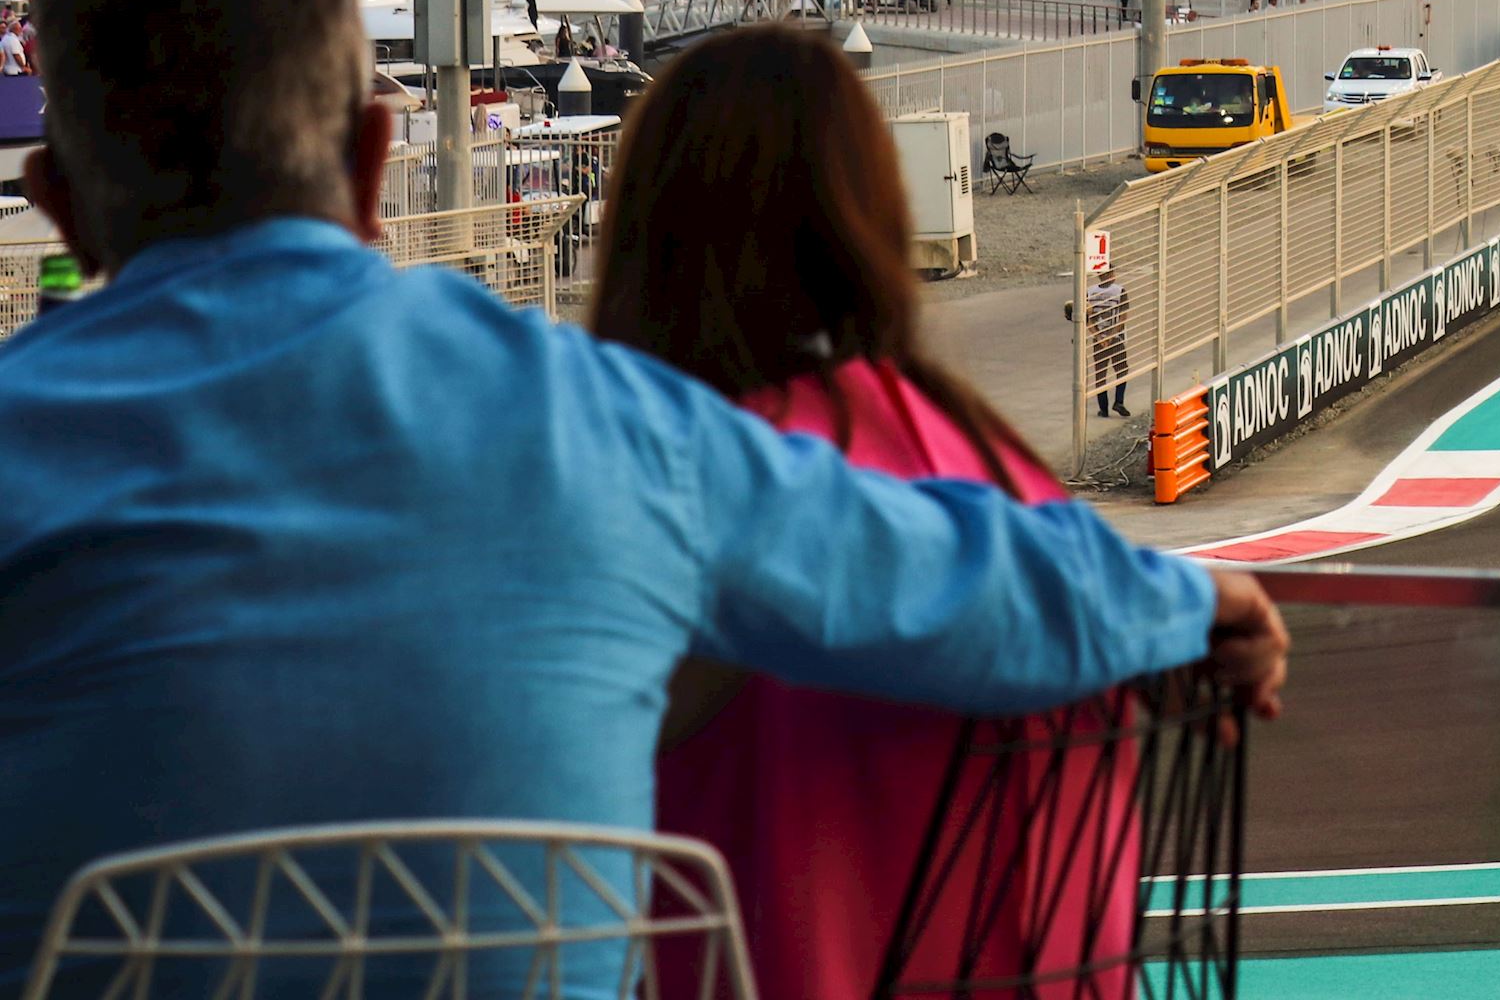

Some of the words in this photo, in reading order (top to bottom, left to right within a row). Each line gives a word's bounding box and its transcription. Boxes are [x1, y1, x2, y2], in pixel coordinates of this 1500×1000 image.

[1384, 284, 1427, 360] ADNOC
[1446, 253, 1485, 324] ADNOC
[1314, 317, 1363, 398] ADNOC
[1233, 356, 1289, 446] ADNOC
